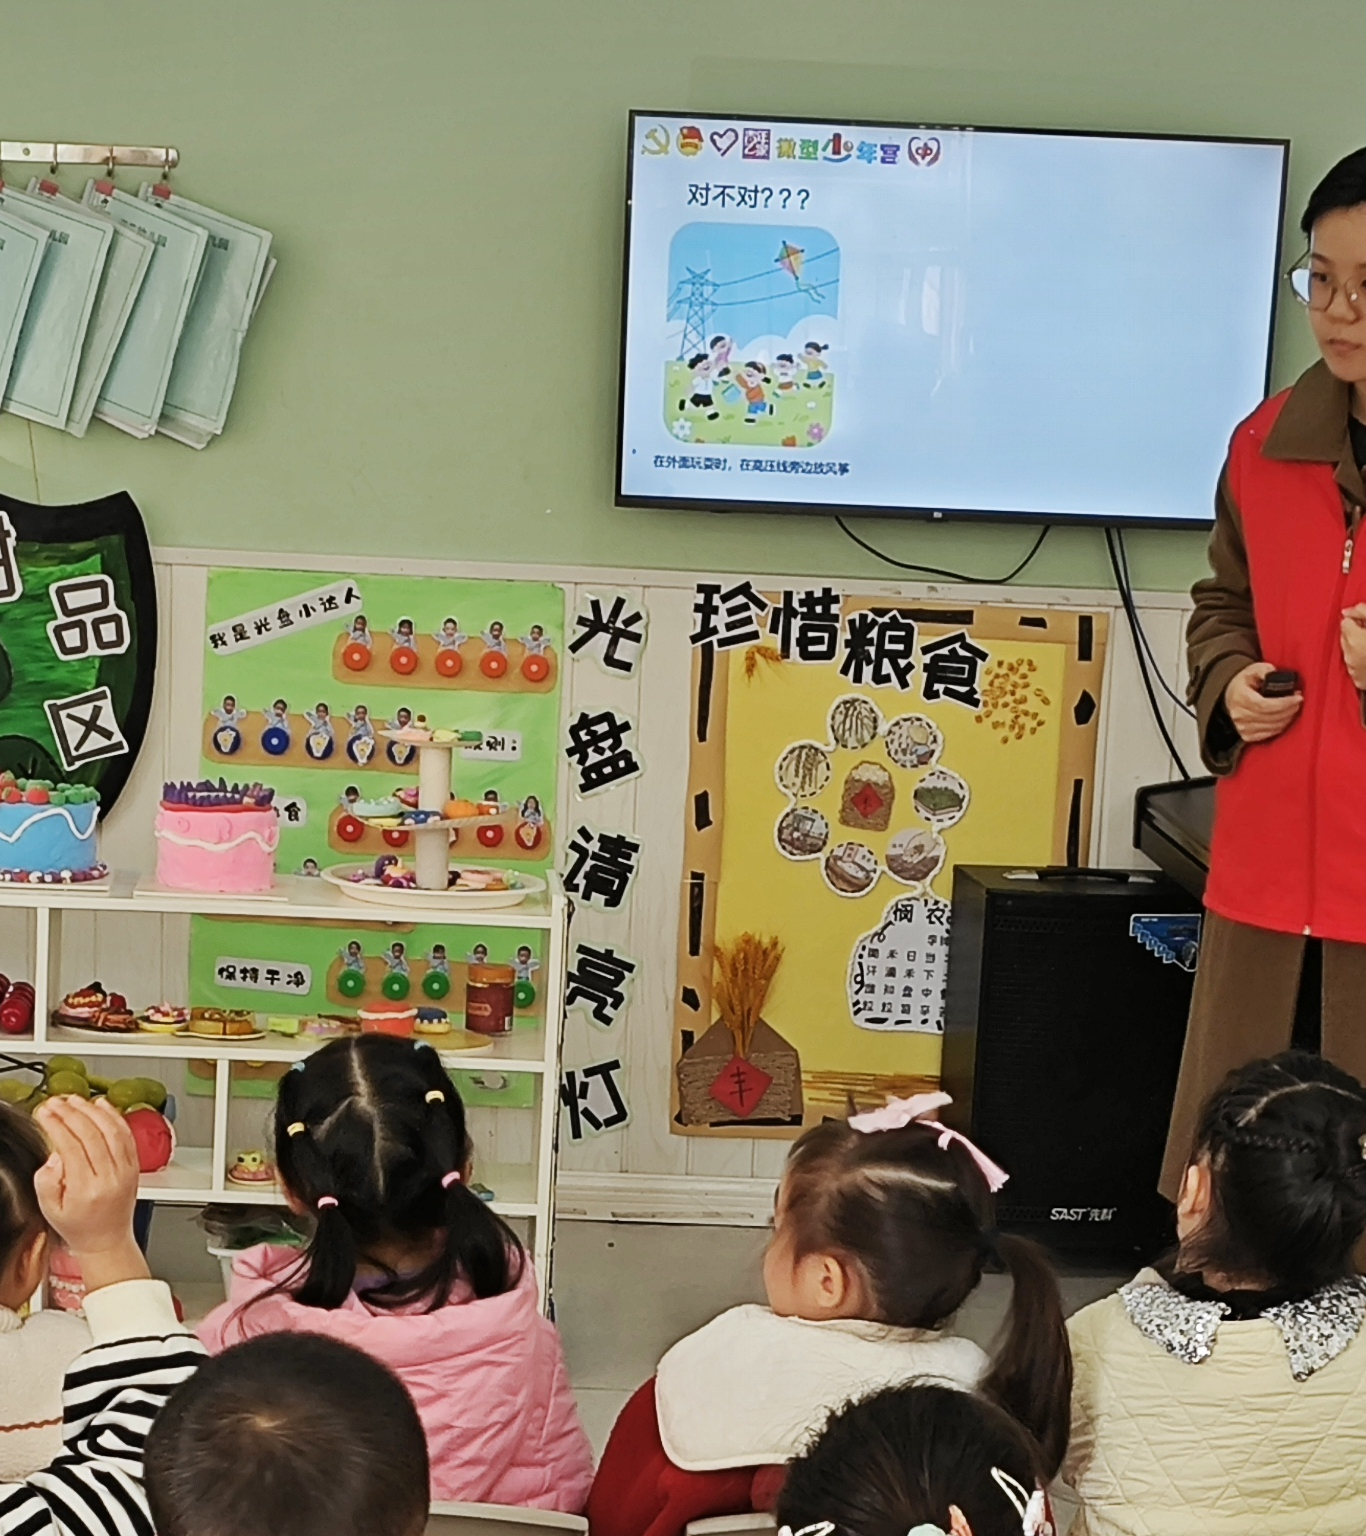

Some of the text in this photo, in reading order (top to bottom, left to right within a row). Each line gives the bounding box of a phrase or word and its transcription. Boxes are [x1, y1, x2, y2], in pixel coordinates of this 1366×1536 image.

[208, 586, 362, 650] 我是光盘小达人
[688, 580, 989, 709] 珍惜粮食
[892, 903, 947, 926] 悯农
[217, 964, 306, 988] 保持干净
[729, 1065, 754, 1108] 丰
[1050, 1206, 1088, 1221] SAST
